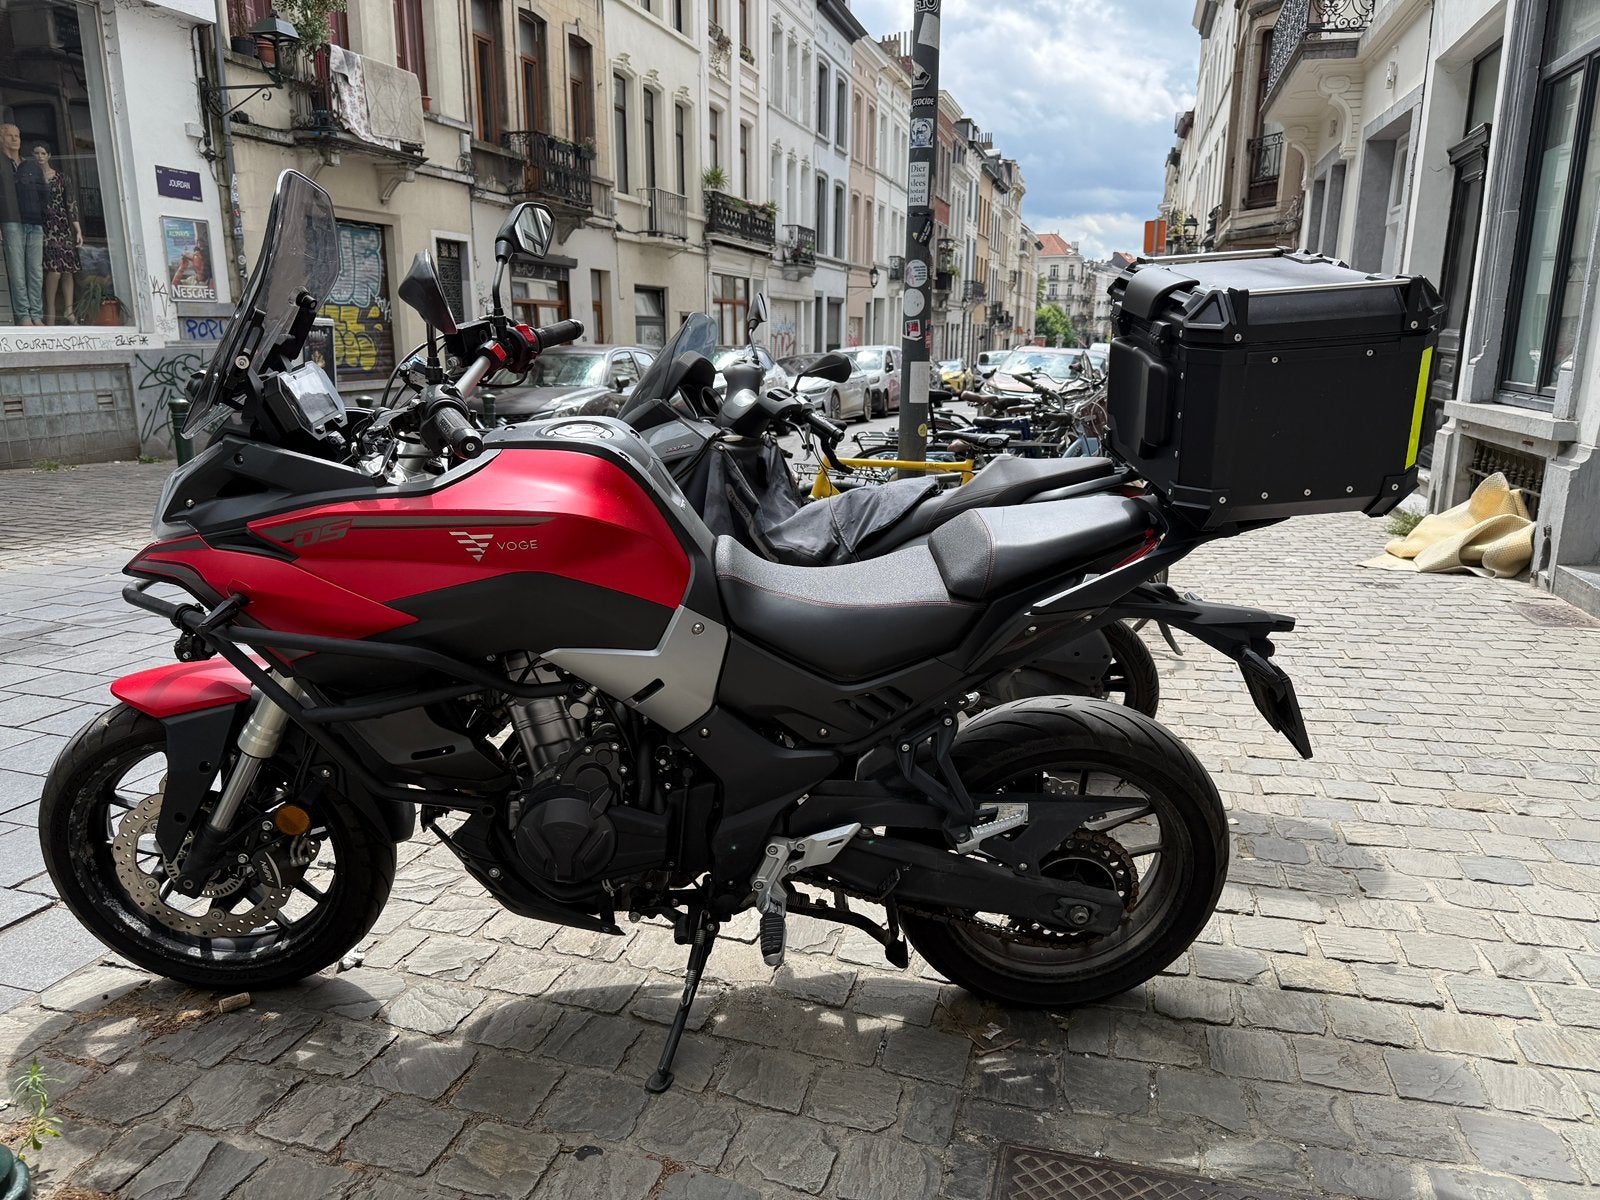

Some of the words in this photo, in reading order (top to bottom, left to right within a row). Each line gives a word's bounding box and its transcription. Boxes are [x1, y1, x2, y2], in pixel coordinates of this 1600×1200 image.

[911, 164, 926, 173] Dier
[168, 179, 191, 190] JOURDAN
[293, 518, 353, 548] DS
[496, 539, 538, 550] VOGE
